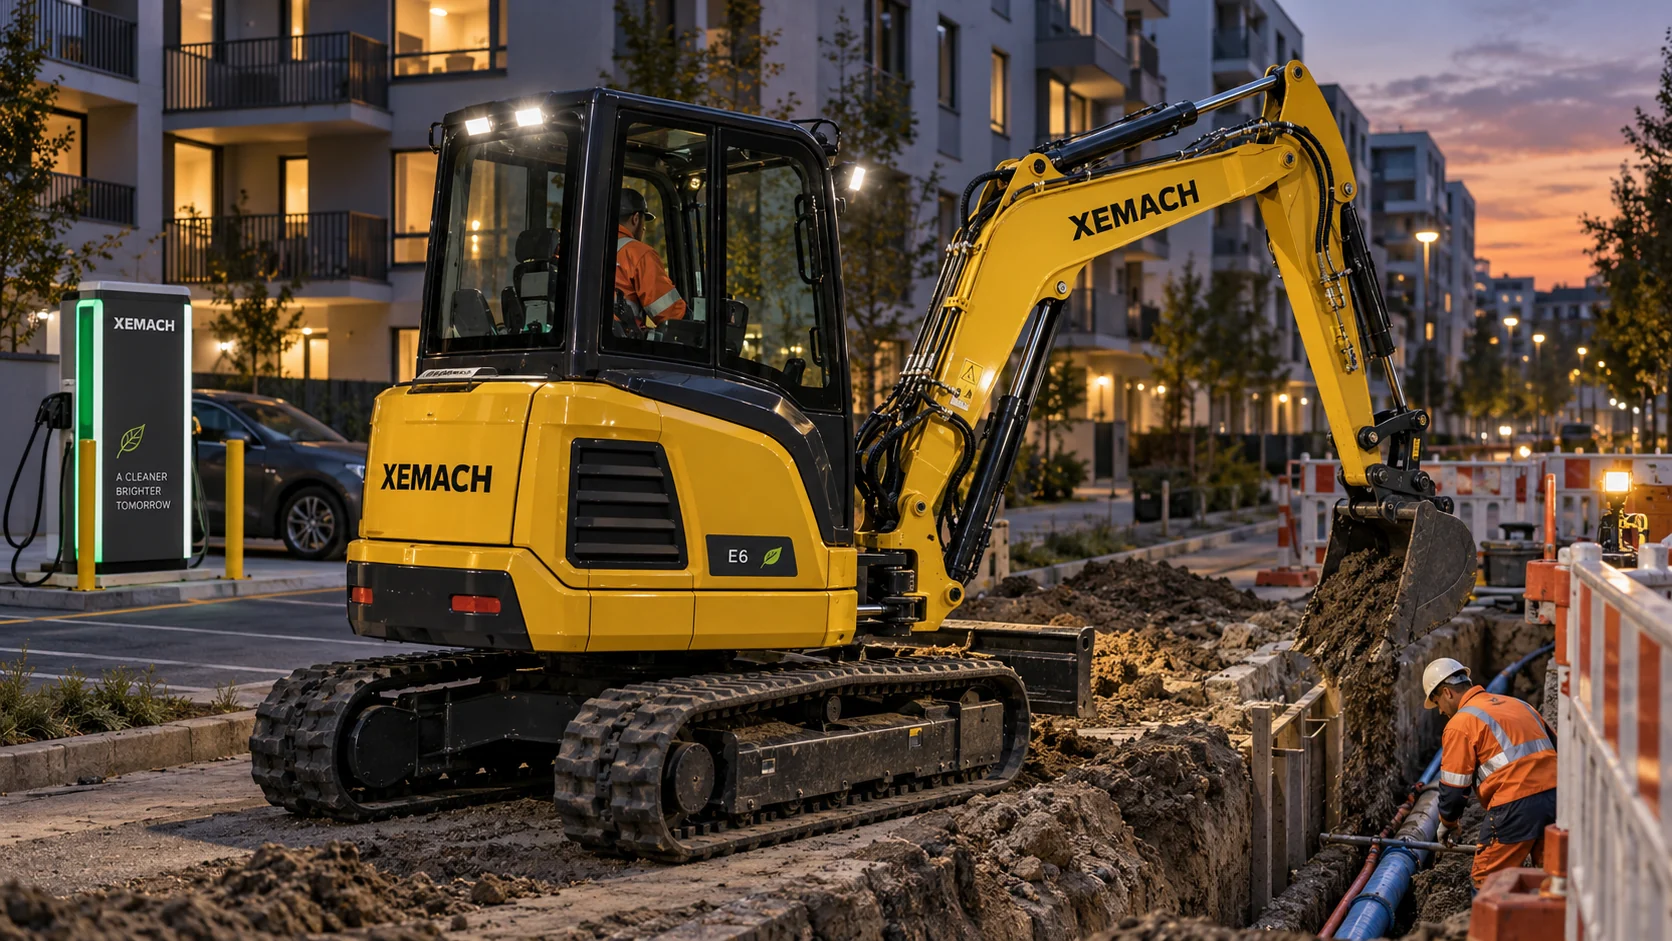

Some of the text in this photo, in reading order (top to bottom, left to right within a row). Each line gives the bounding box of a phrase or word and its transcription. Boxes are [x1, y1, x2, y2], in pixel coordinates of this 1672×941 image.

[1068, 180, 1199, 241] XEMACH
[114, 317, 175, 332] XEMACH
[116, 472, 168, 482] A CLEANER
[381, 463, 492, 493] XEMACH
[116, 486, 162, 496] BRIGHTER
[116, 500, 171, 510] TOMORROW
[728, 549, 749, 564] E6
